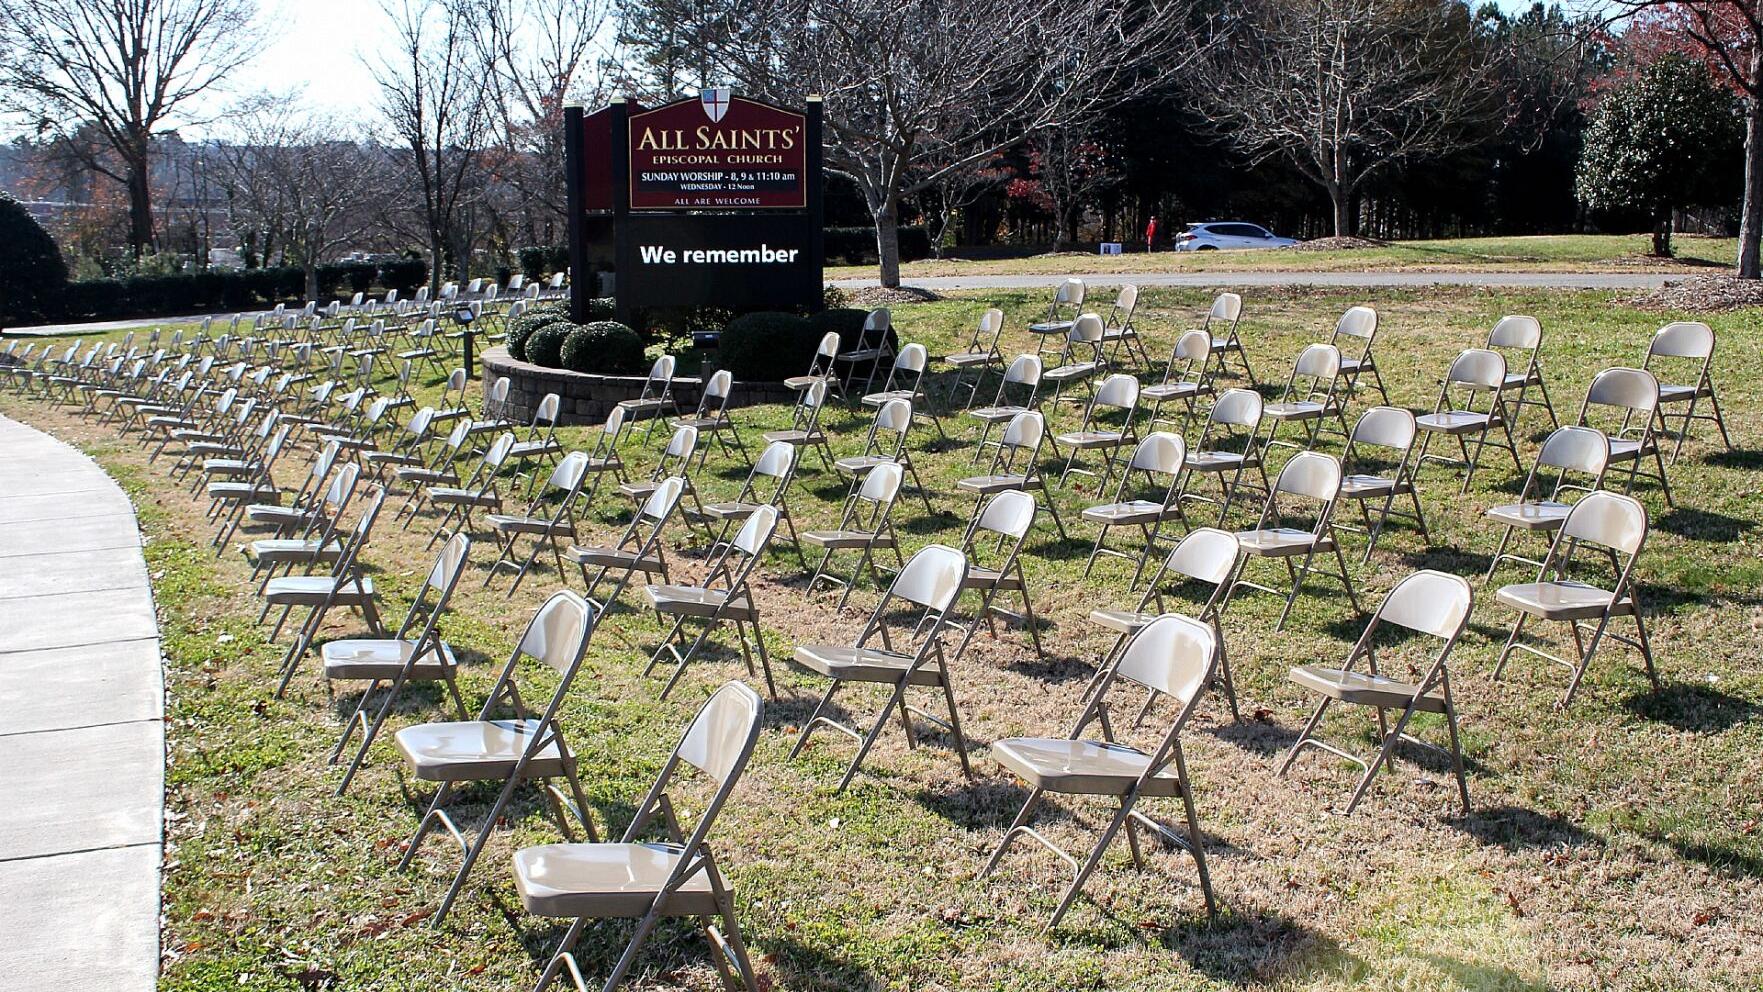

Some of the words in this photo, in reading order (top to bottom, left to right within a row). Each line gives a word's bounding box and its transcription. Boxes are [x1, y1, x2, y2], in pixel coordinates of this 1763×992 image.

[637, 127, 689, 150] ALL
[653, 155, 720, 164] EPISCOPAL
[727, 155, 783, 164] CHURCH
[641, 172, 679, 181] SUNDAY
[680, 172, 724, 181] WORSHIP
[730, 172, 739, 182] 8,
[741, 172, 747, 181] 9
[756, 172, 780, 181] 11:10
[640, 246, 676, 263] We
[683, 244, 799, 263] remember
